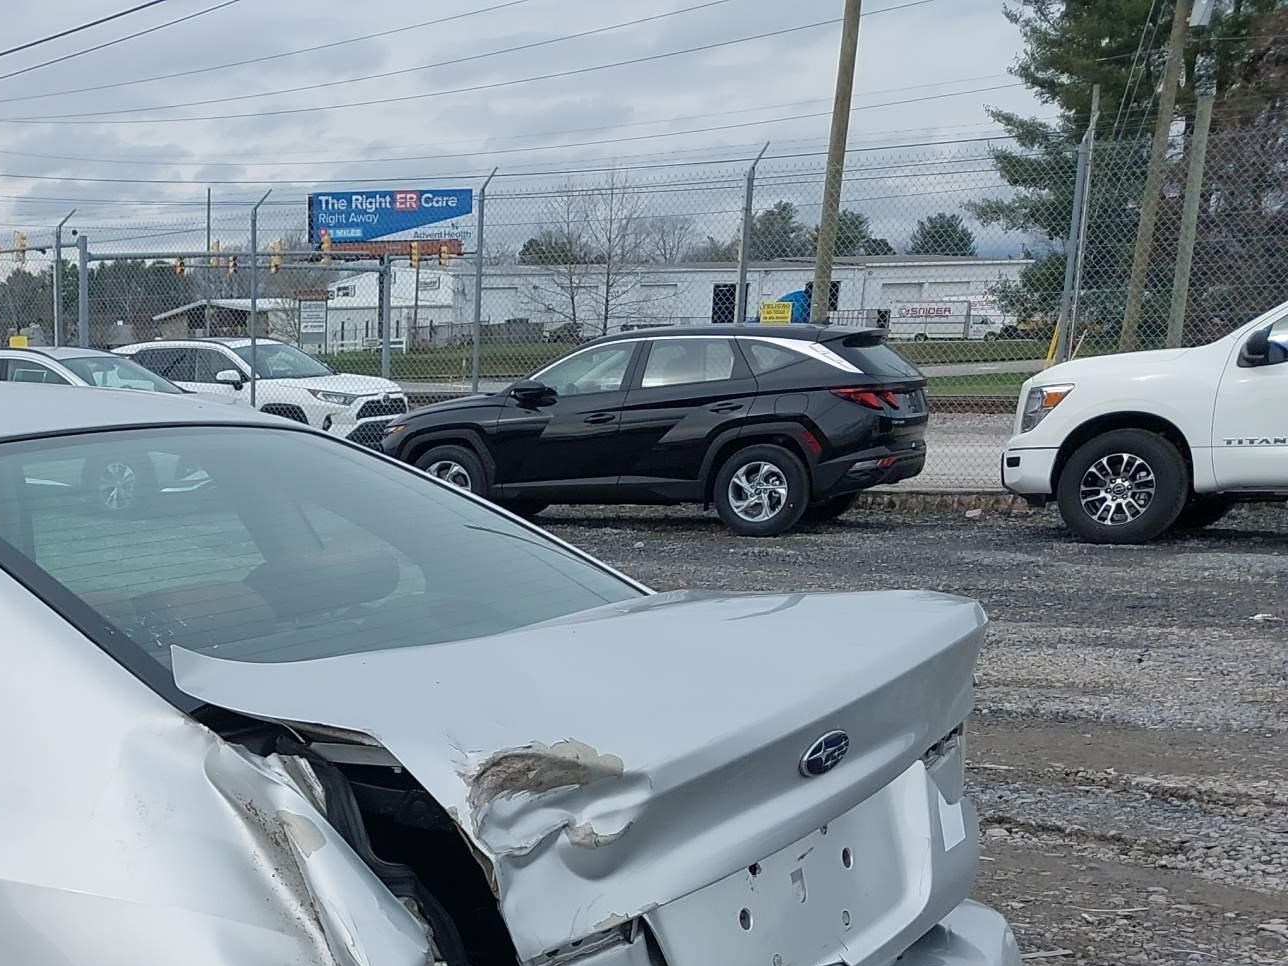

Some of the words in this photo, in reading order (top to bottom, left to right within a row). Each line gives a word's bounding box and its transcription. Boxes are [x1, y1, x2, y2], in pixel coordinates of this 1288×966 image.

[318, 195, 347, 209] The
[352, 194, 391, 211] Right
[396, 193, 417, 208] ER
[421, 193, 457, 207] Care
[318, 213, 346, 225] Right
[349, 212, 380, 224] Away
[910, 307, 952, 315] SNIDER
[1223, 437, 1287, 445] TITAN
